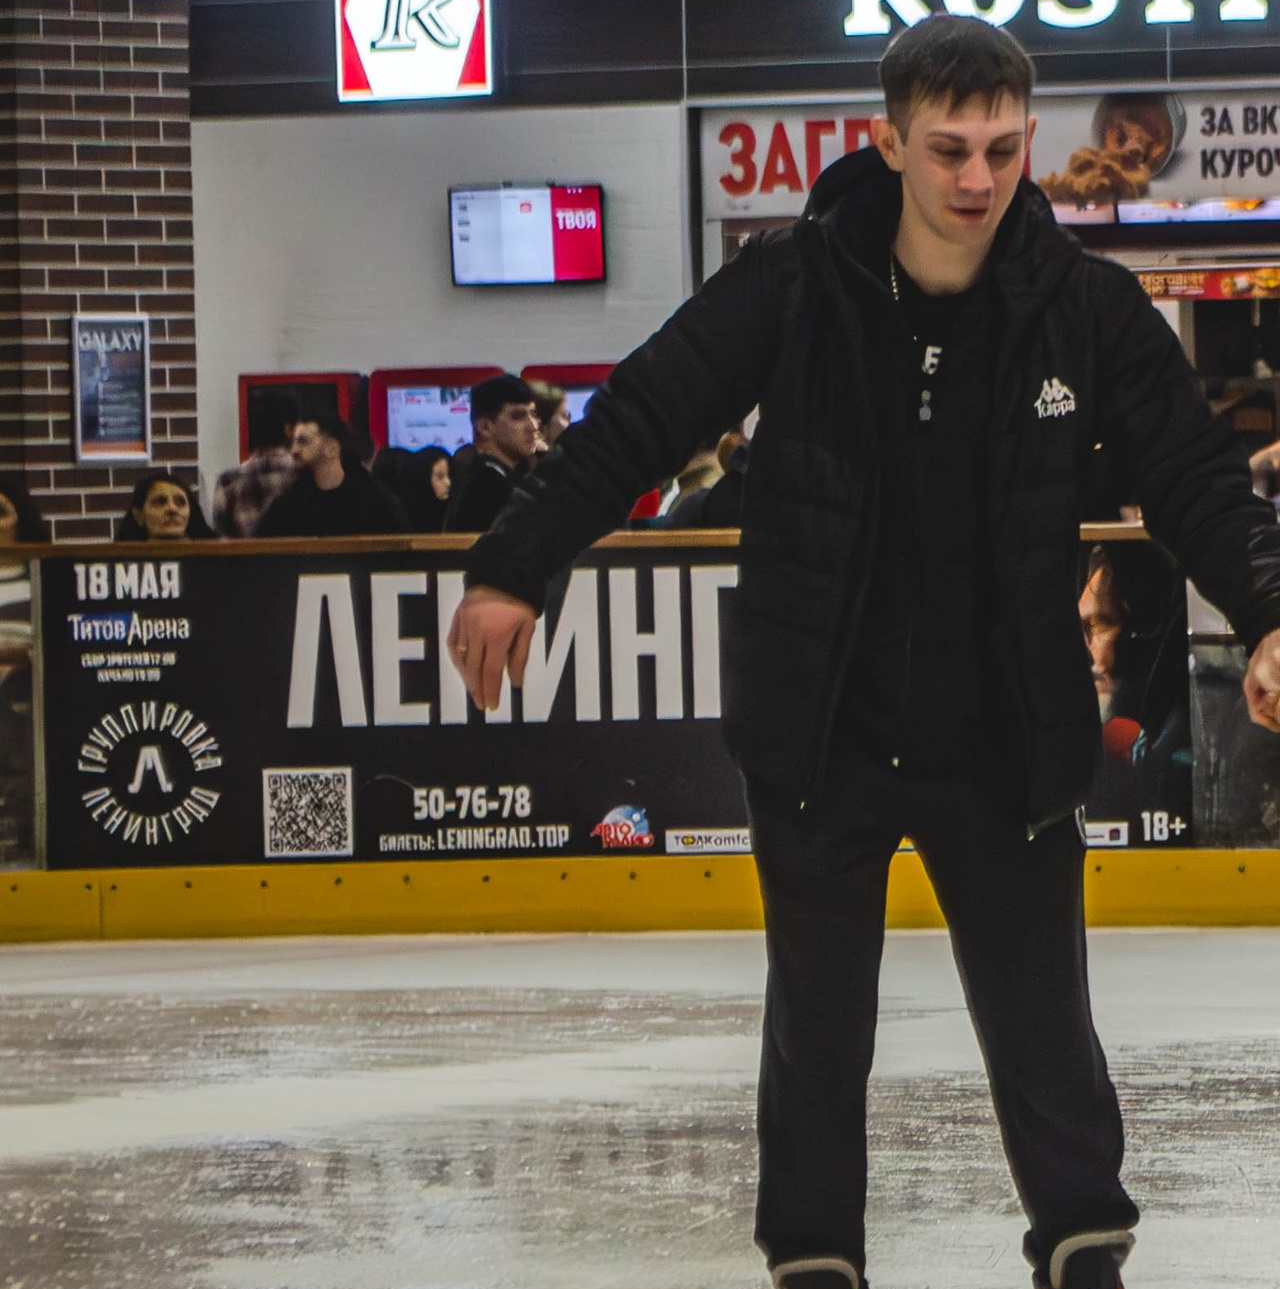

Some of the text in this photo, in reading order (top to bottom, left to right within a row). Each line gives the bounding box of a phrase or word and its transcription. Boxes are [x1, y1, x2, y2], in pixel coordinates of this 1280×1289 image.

[1200, 112, 1235, 137] ЗА
[79, 329, 142, 351] GALAXY
[73, 562, 180, 601] 18 МАЯ
[81, 786, 222, 846] ЛЕНИНГРАД
[413, 786, 532, 821] 50-76-78
[379, 825, 570, 852] БИЛЕТЫ: LENINGRAD.TOP
[1141, 811, 1187, 841] 18+
